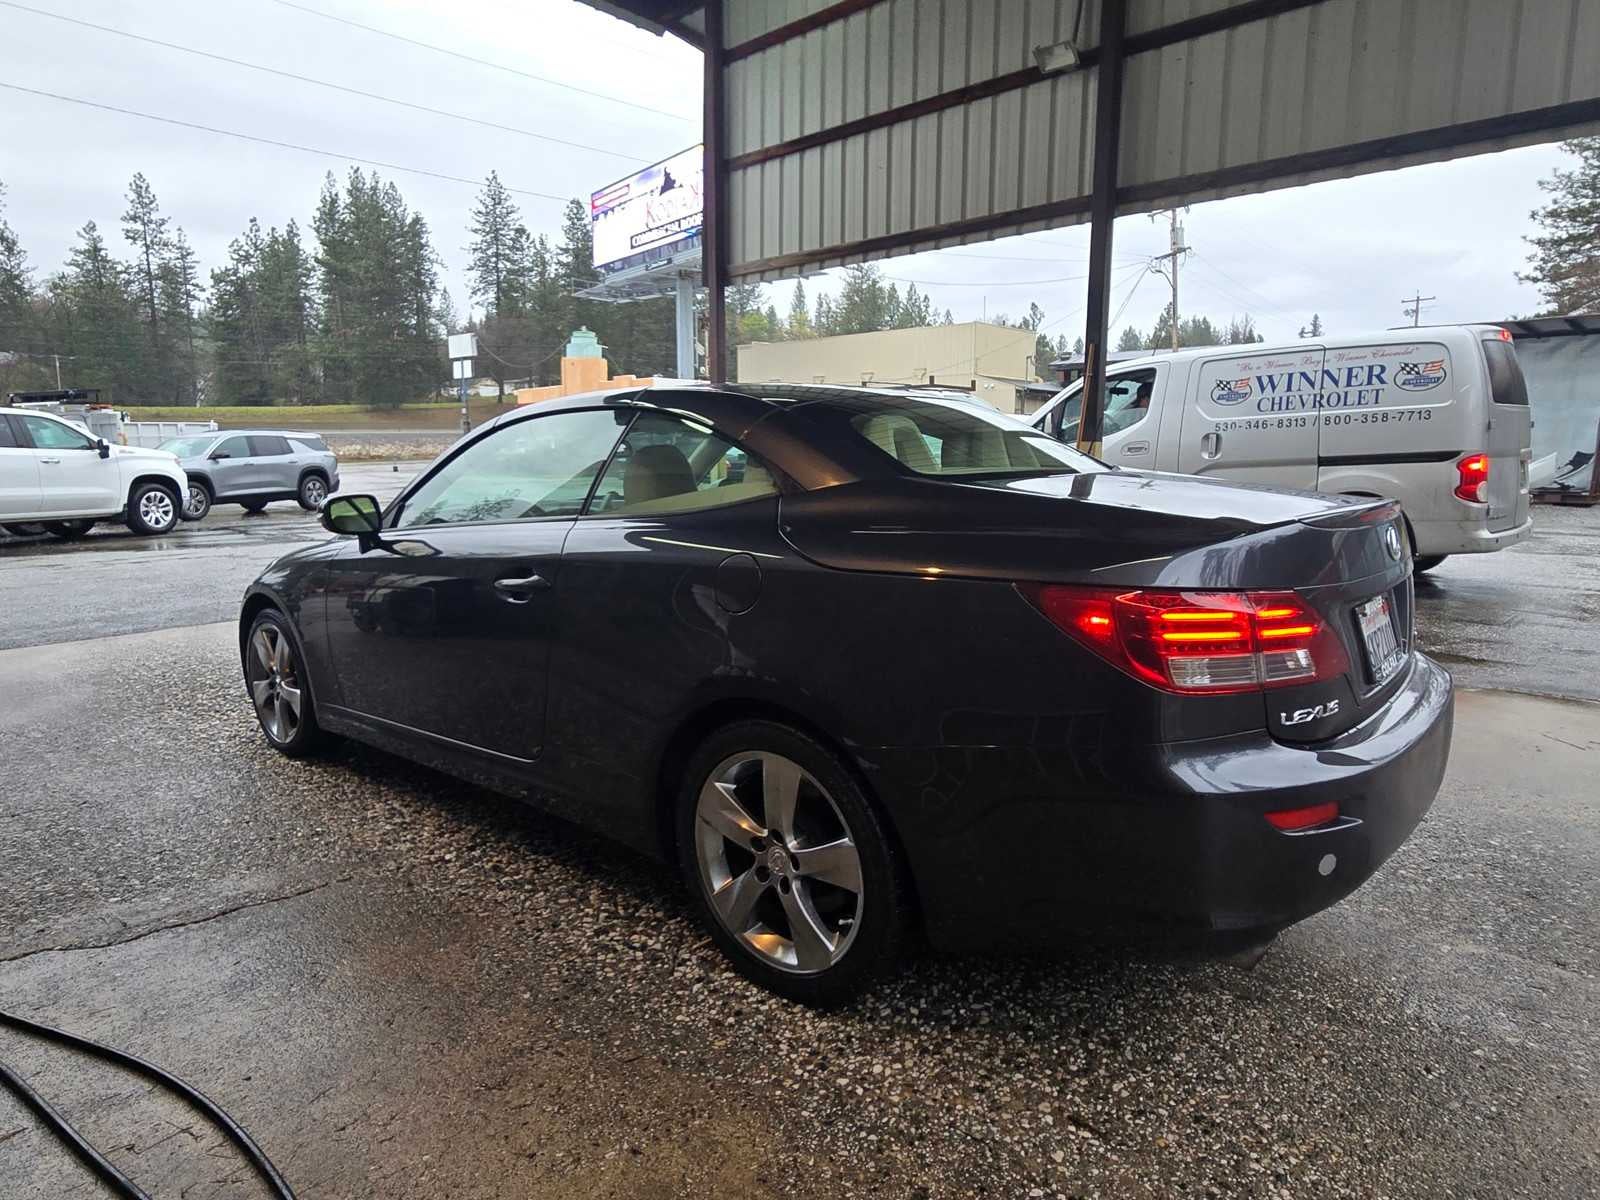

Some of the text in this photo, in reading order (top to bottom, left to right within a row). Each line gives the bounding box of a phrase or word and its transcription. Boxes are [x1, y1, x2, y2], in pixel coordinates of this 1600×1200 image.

[1255, 364, 1389, 395] WINNER
[1256, 388, 1385, 412] CHEVROLET
[1214, 417, 1307, 432] 530-346-8313
[1324, 409, 1432, 426] 800-358-7713
[1280, 700, 1340, 726] LEXUS
